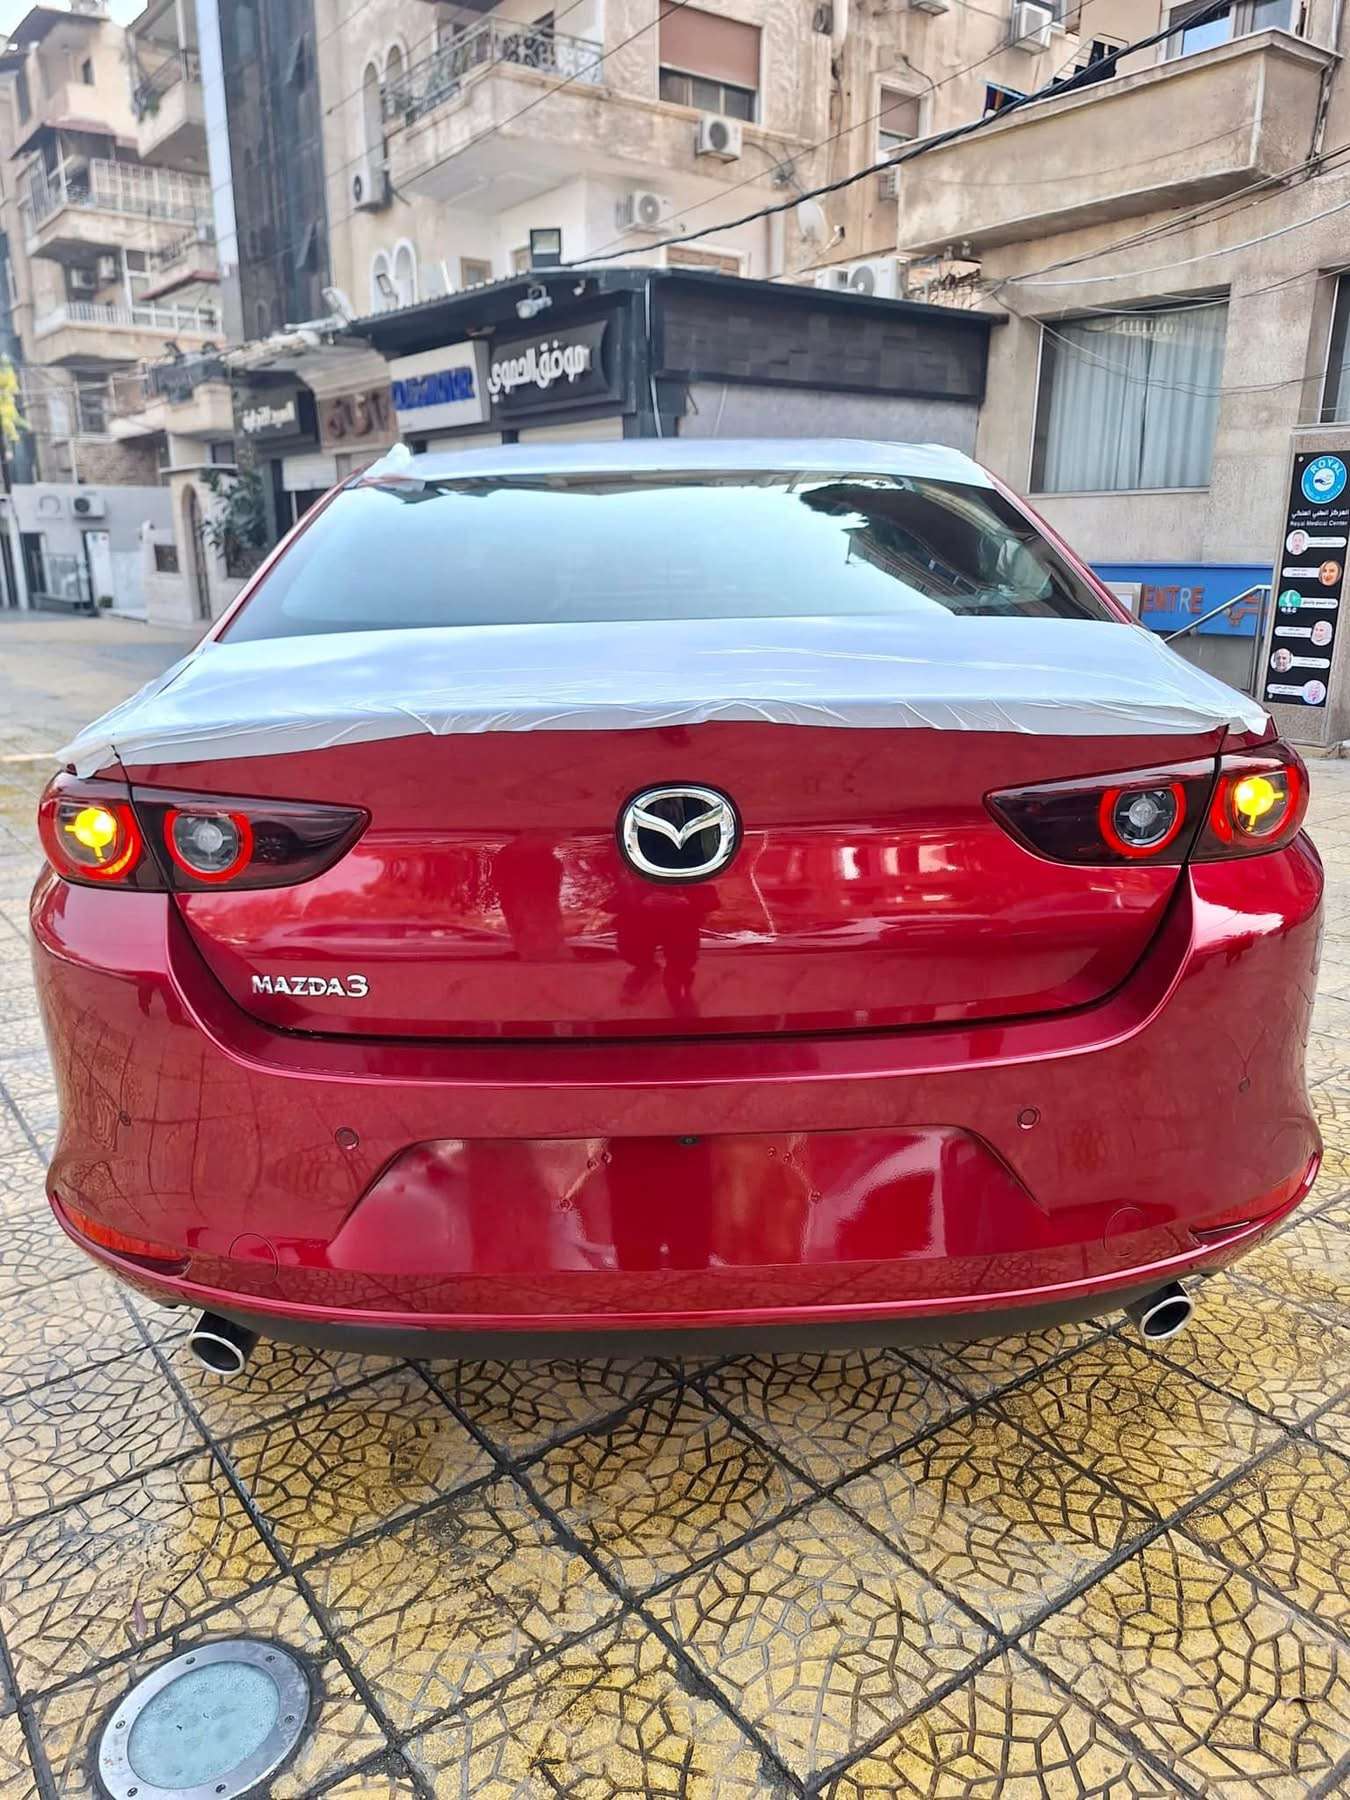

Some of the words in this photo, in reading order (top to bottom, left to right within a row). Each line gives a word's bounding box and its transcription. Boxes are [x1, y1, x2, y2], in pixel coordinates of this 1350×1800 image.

[487, 347, 537, 404] الحموي
[536, 339, 591, 389] موفق
[1310, 458, 1344, 476] ROYAL
[1328, 519, 1348, 527] Center
[251, 974, 369, 998] MAZDA3
